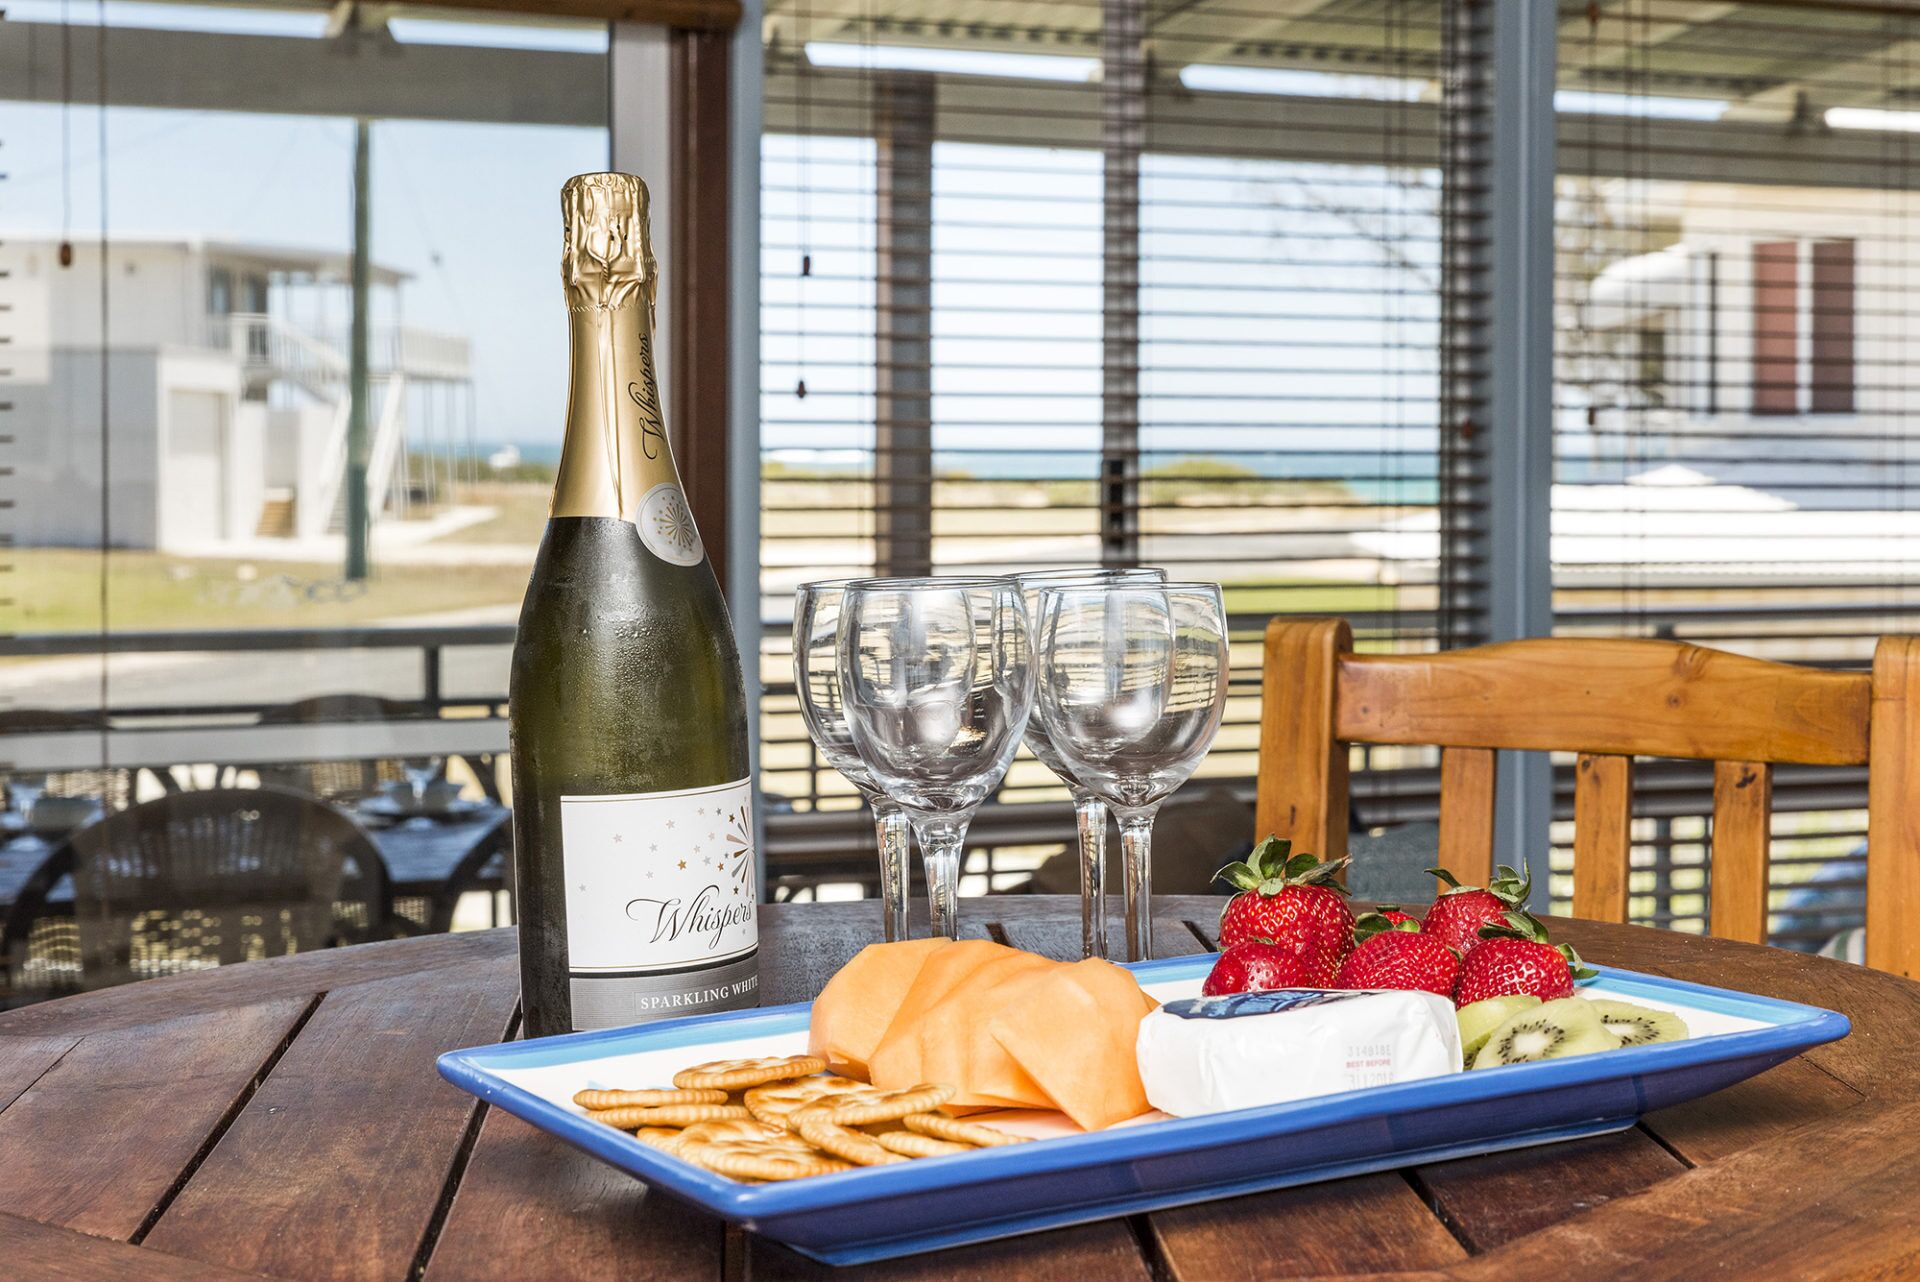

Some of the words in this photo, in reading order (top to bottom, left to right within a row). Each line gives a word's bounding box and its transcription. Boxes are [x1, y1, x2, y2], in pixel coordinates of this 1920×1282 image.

[627, 332, 665, 460] Whispers
[625, 884, 752, 950] Whispers
[640, 986, 730, 1010] SPARKLING
[1345, 1060, 1364, 1069] BEST
[1365, 1058, 1392, 1067] BEFORE
